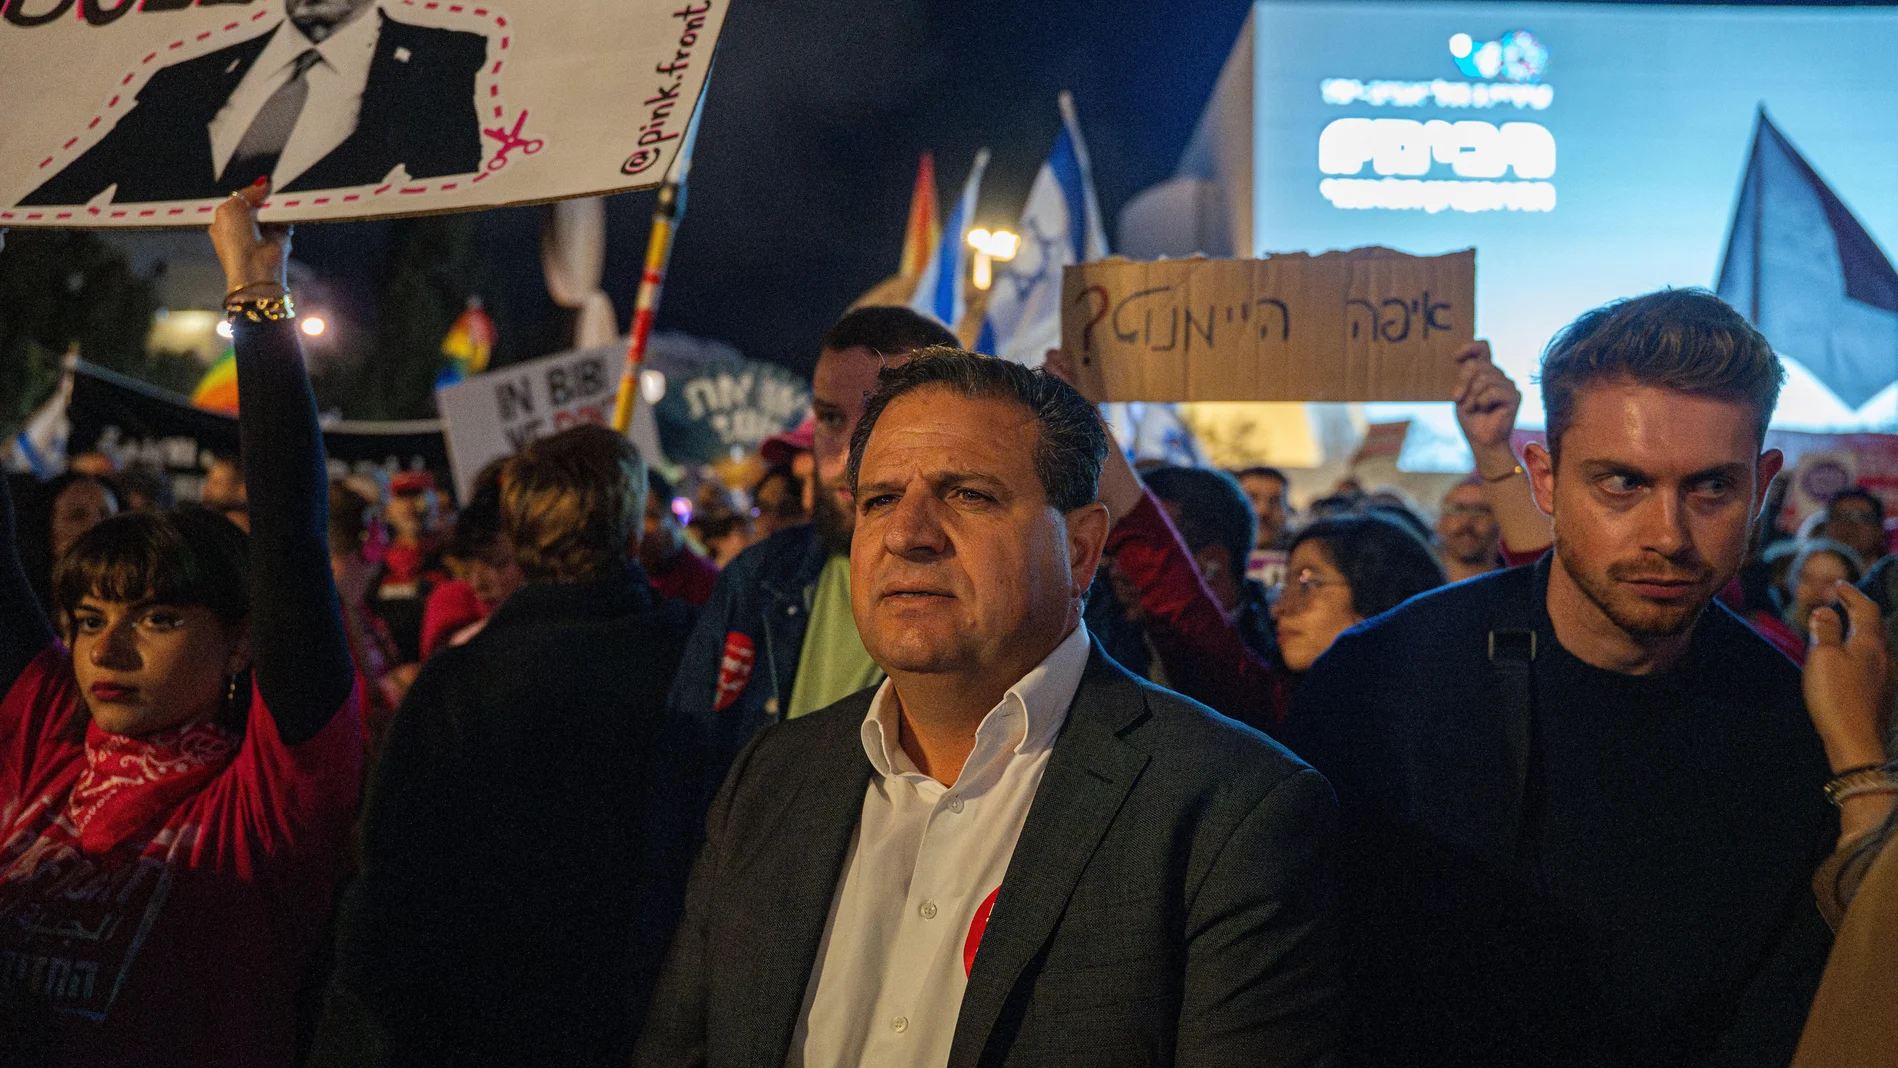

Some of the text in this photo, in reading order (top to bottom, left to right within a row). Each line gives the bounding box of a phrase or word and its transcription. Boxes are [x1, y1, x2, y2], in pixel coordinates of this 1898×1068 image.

[620, 0, 713, 175] @pink.front
[1346, 290, 1453, 343] איפה
[496, 372, 535, 422] IN
